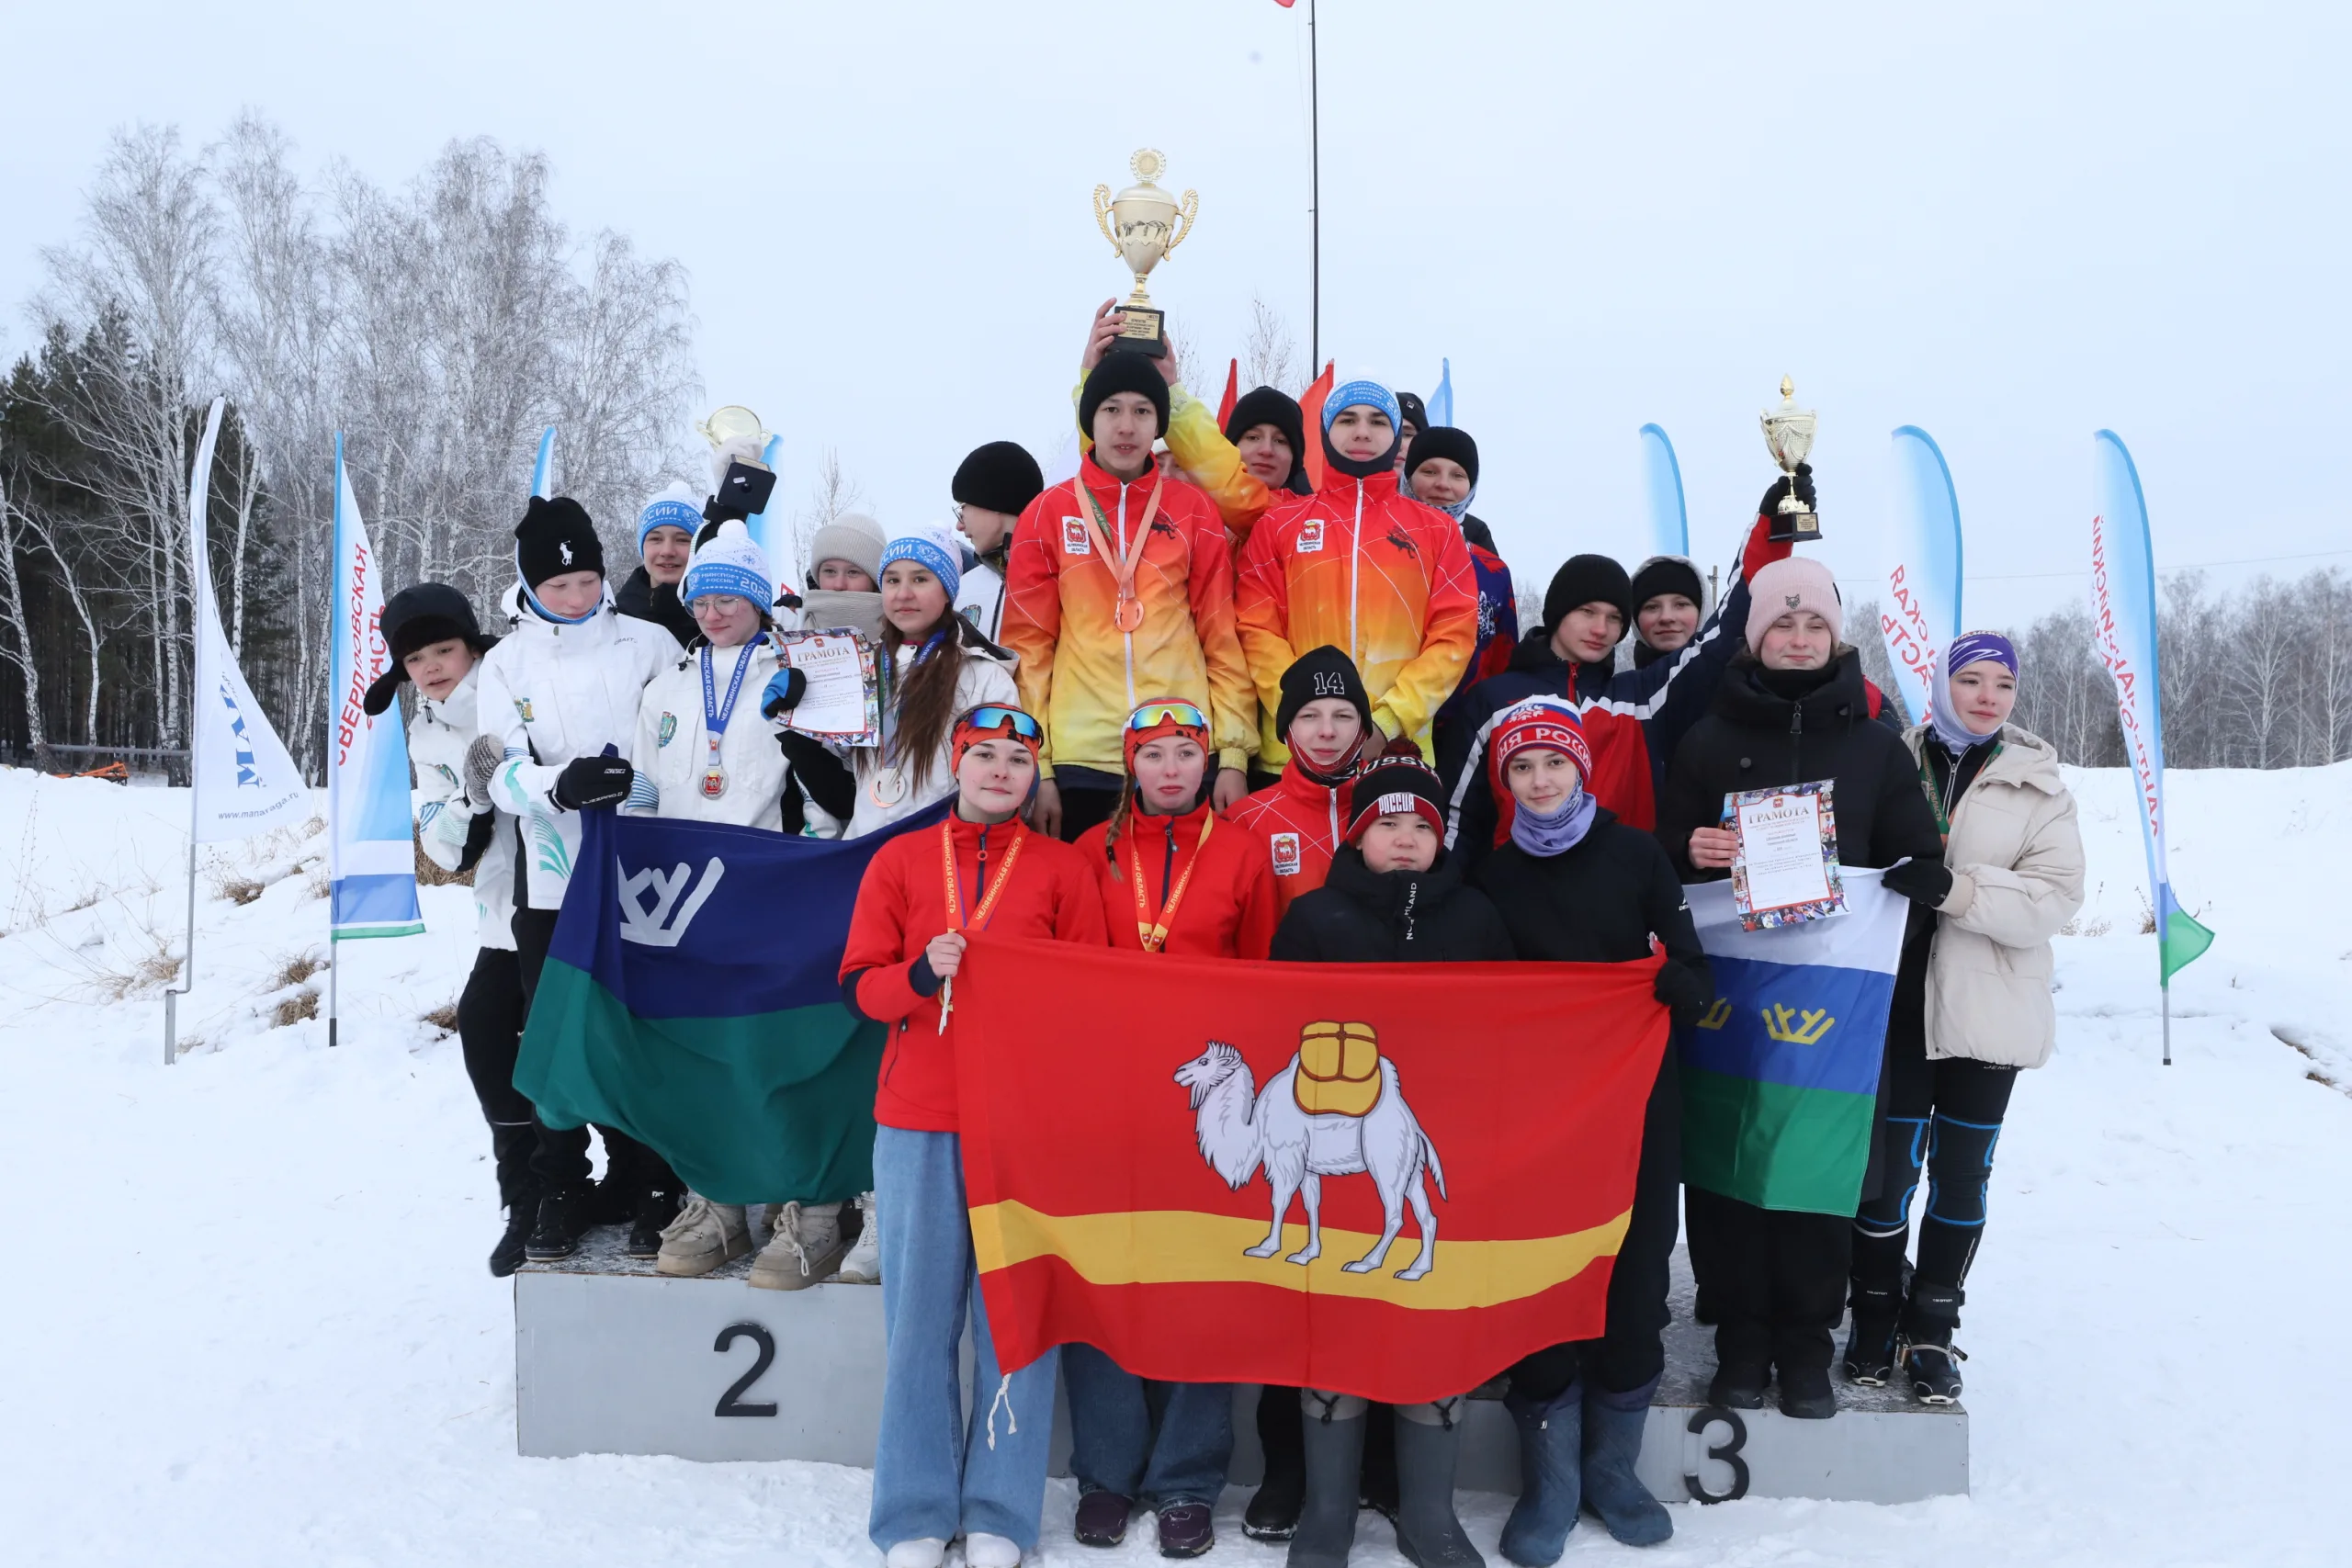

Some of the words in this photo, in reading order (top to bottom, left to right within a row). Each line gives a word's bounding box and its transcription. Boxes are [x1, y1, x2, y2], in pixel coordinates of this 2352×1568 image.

[883, 543, 912, 562] СИИ
[740, 576, 771, 604] 2025
[703, 643, 712, 684] ЯБИНСКАЯ
[797, 647, 851, 662] ГРАМОТА
[720, 670, 742, 721] ЧЕЛЯБИНСКАЯ
[739, 642, 755, 670] ОБЛАСТЬ
[1313, 671, 1345, 695] 14
[706, 685, 715, 718] ОБЛАСТЬ
[218, 791, 300, 819] www.manaraga.ru
[1748, 806, 1810, 825] ГРАМОТА
[943, 823, 954, 876] ЧЕЛЯБИНСКАЯ
[946, 877, 956, 914] ОБЛАСТЬ
[975, 867, 1008, 920] ЧЕЛЯБИНСКАЯ
[1004, 836, 1022, 869] ОБЛАСТЬ
[1135, 872, 1146, 908] ОБЛАСТЬ
[714, 1323, 777, 1416] 2
[1684, 1405, 1749, 1506] 3
